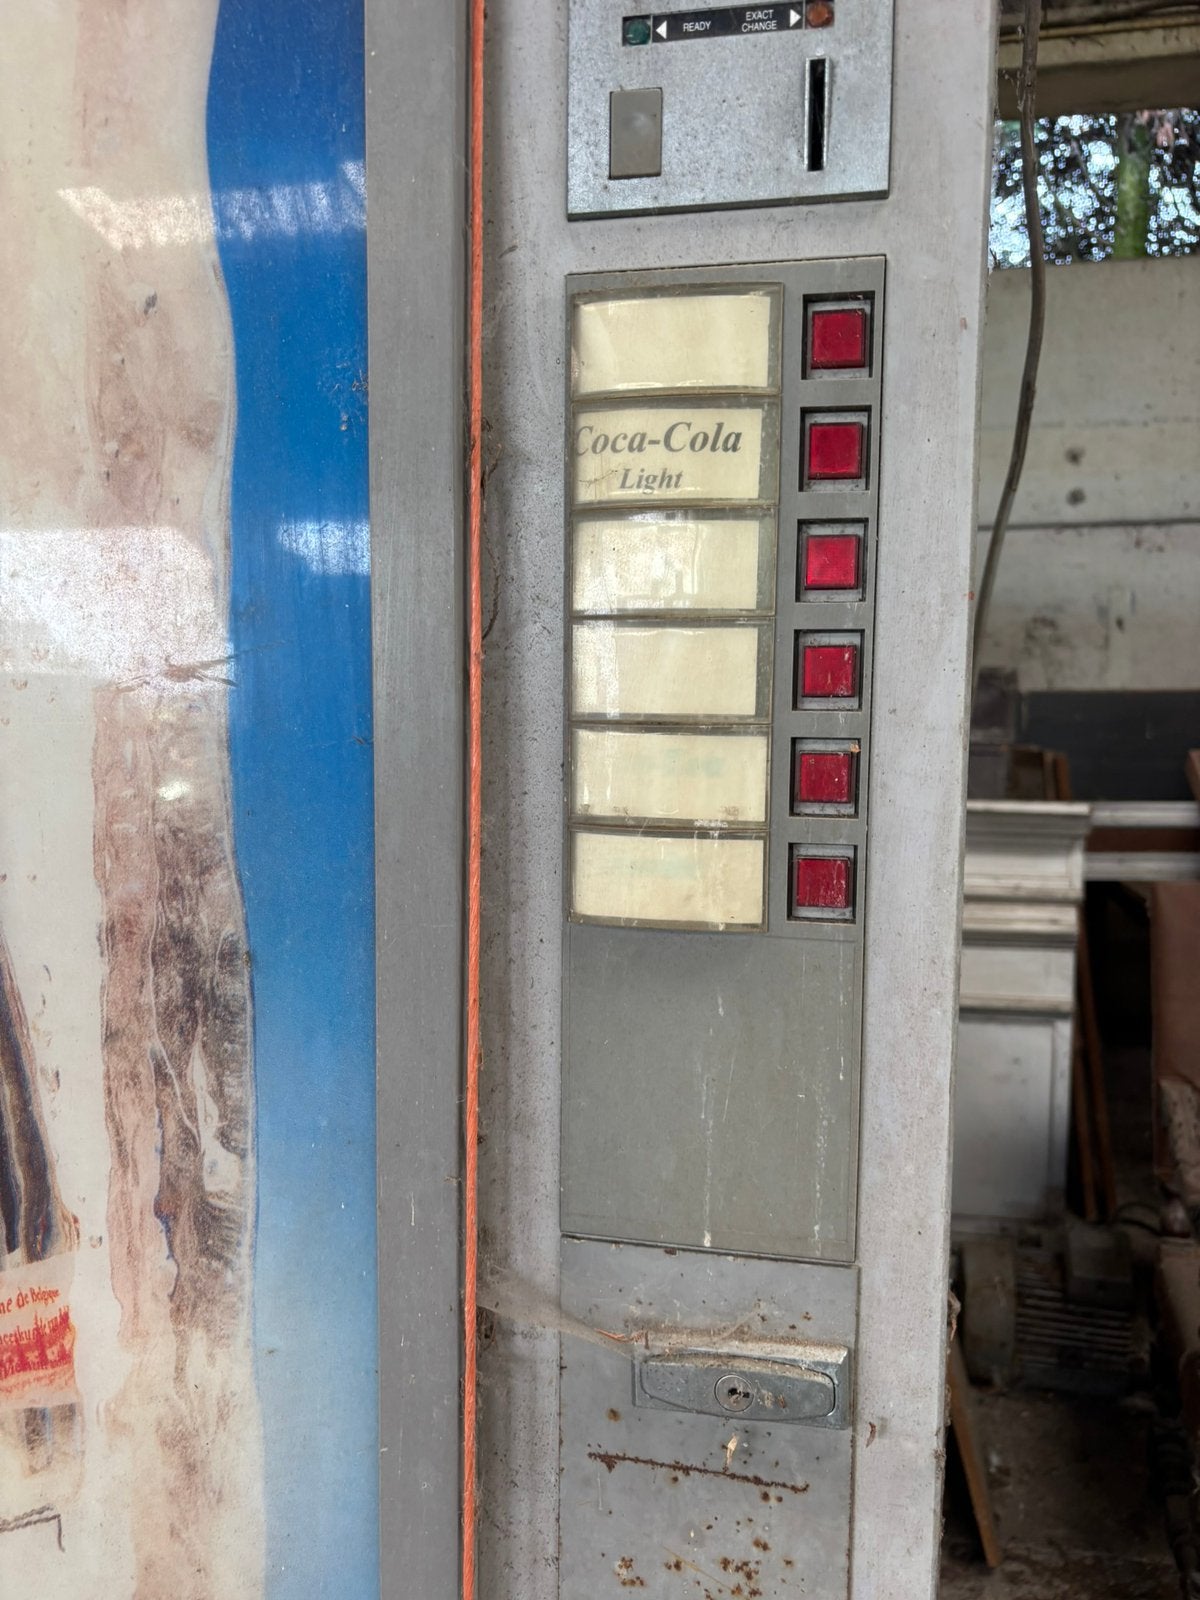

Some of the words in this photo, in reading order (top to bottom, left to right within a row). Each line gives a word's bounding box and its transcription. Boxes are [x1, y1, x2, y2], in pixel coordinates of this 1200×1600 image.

[746, 10, 773, 21] EXACT
[683, 21, 711, 32] READY
[742, 21, 777, 32] CHANGE
[576, 422, 742, 456] Coca-Cola
[620, 467, 683, 494] Light
